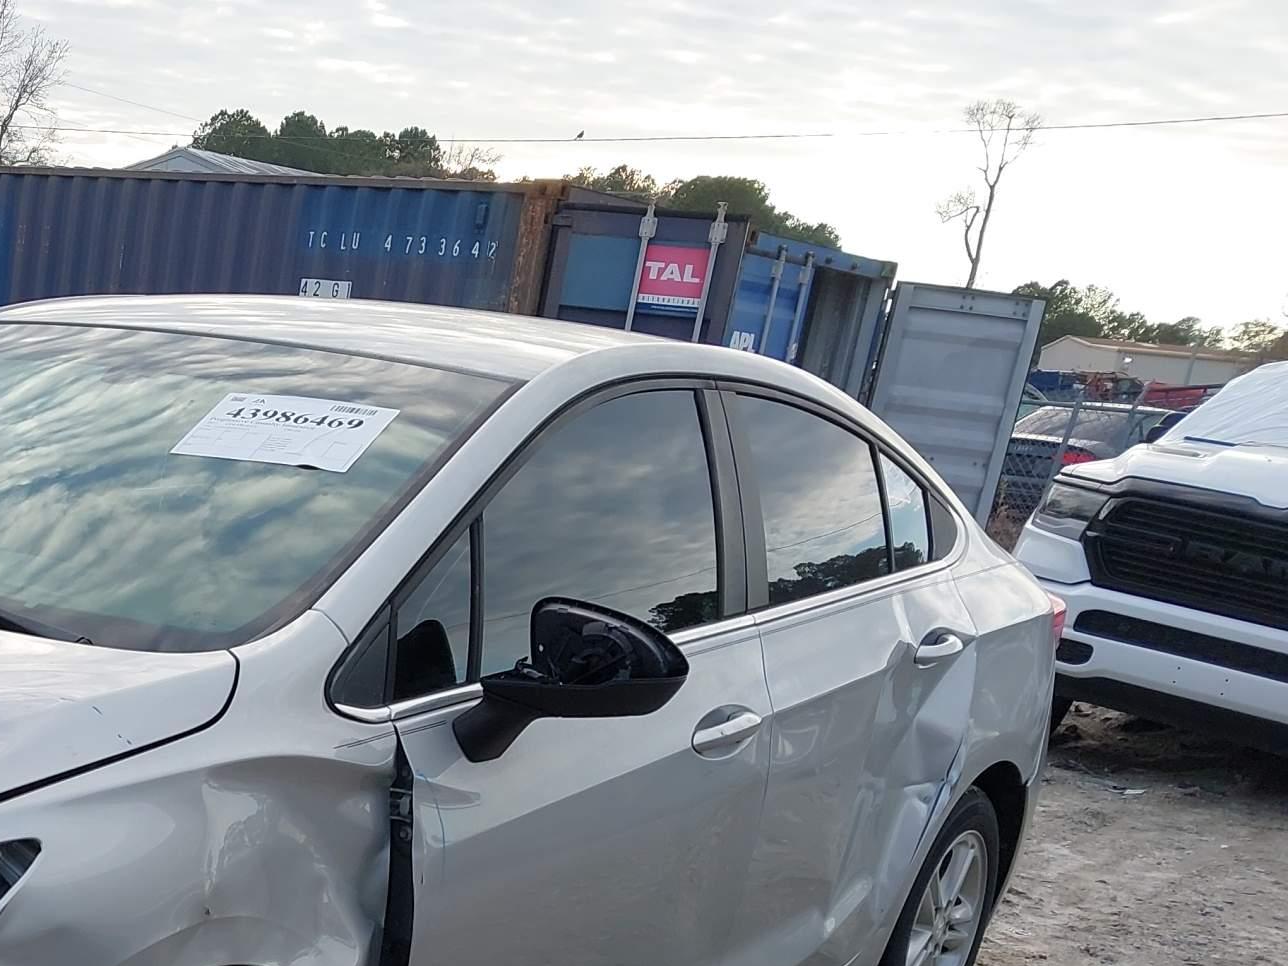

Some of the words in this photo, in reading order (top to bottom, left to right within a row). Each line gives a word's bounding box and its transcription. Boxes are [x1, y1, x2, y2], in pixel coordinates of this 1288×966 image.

[645, 261, 701, 283] TAL
[729, 330, 756, 352] APL
[226, 407, 365, 429] 43986469
